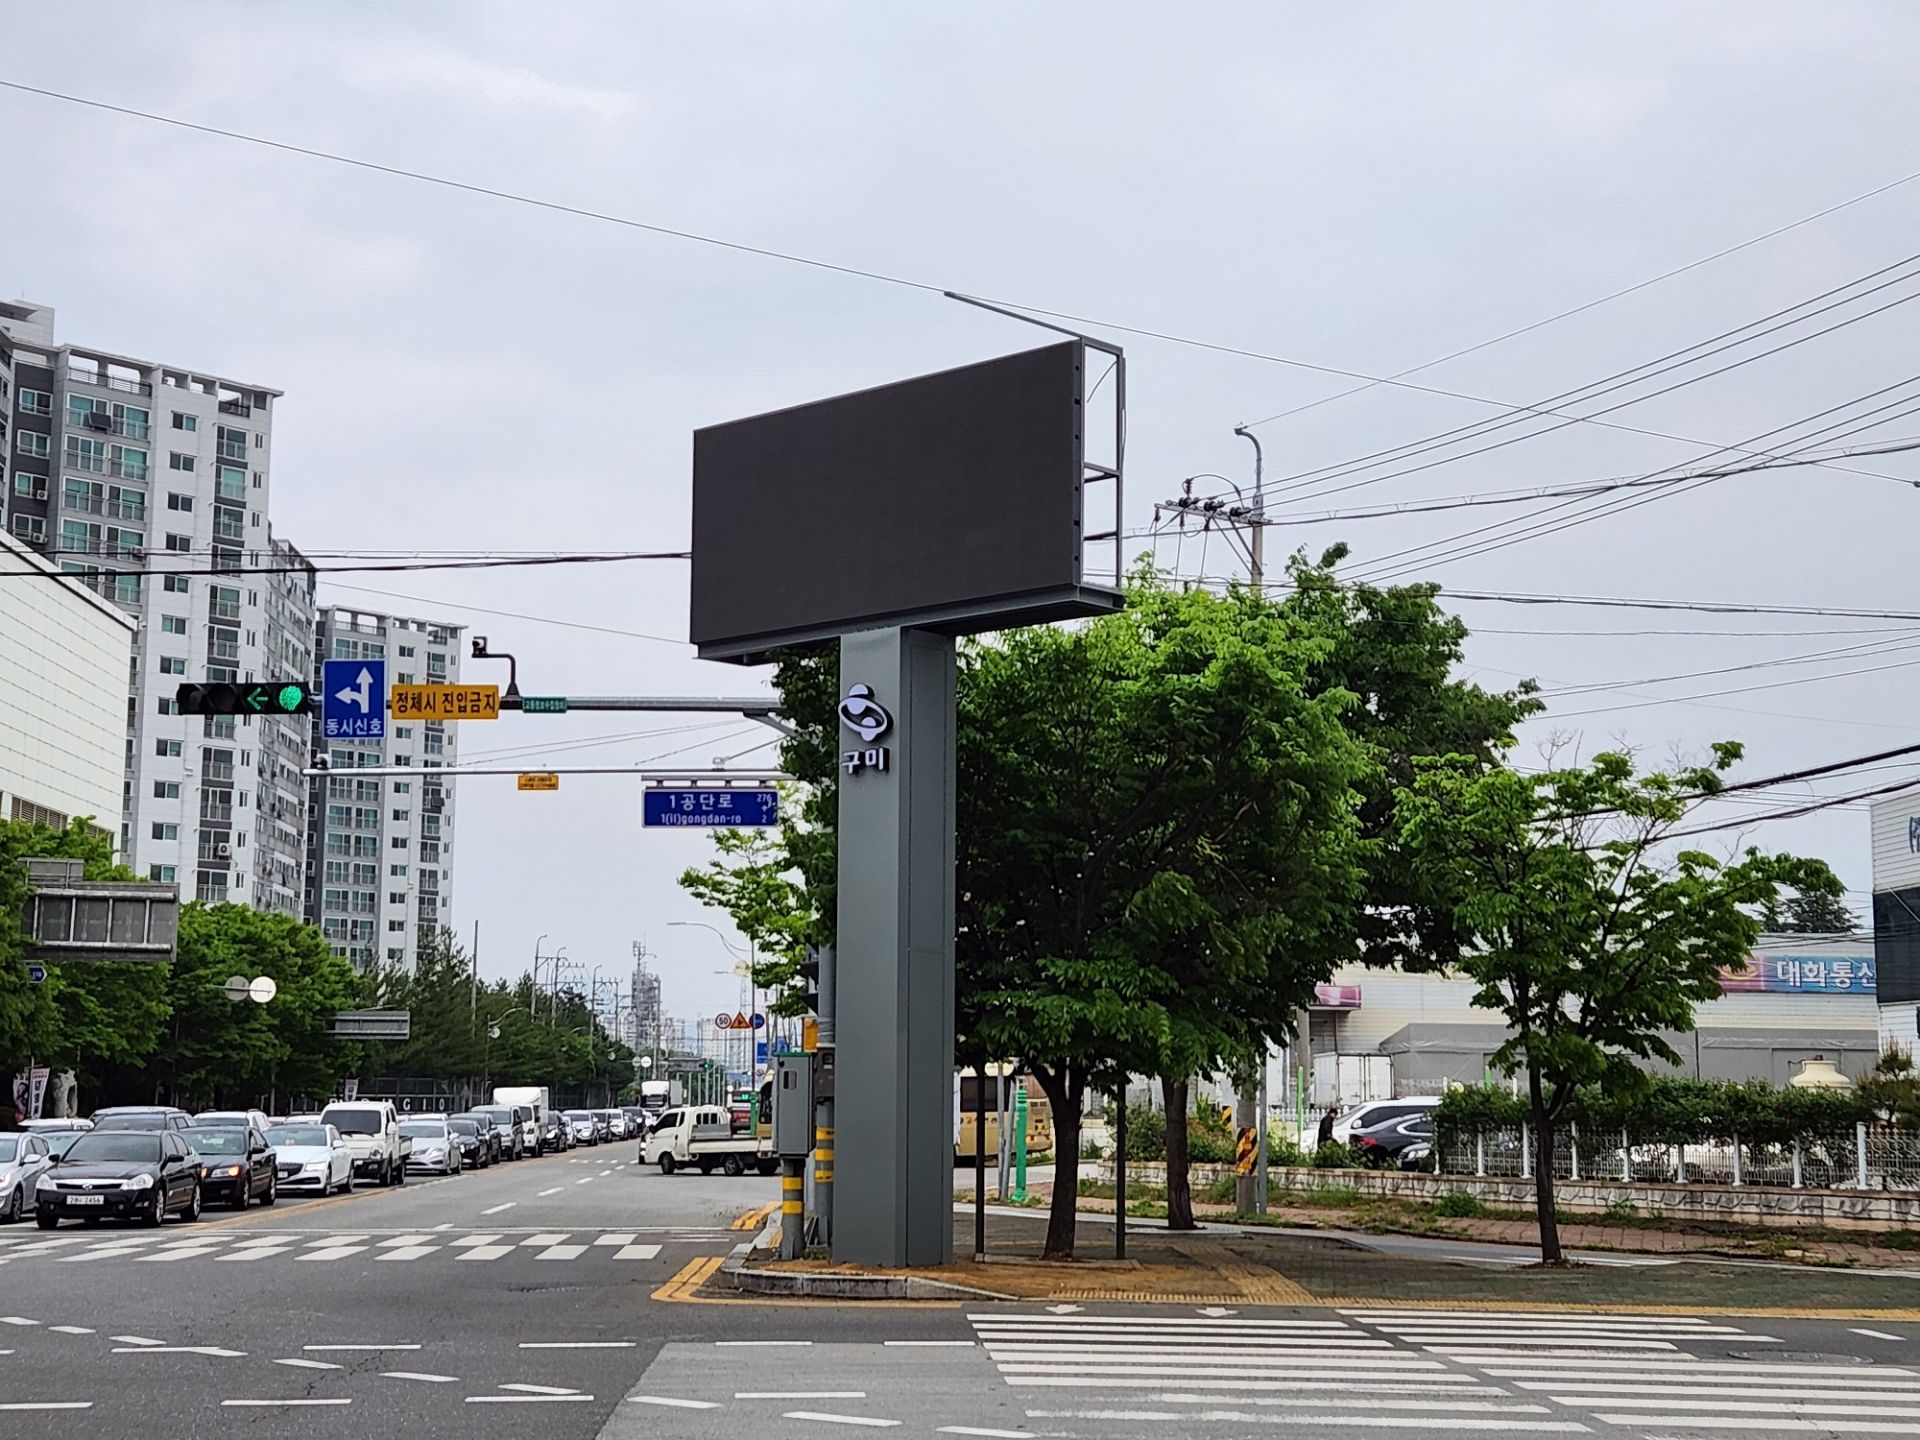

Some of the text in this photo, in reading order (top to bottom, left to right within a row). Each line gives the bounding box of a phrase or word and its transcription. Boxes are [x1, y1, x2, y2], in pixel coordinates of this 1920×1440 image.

[396, 691, 496, 714] 정체시 진입금지
[325, 718, 383, 735] 동시신호
[841, 747, 884, 774] 구미
[669, 793, 733, 811] 1공단로
[660, 813, 742, 825] 1(il)gongdan-ro
[761, 814, 767, 824] 2
